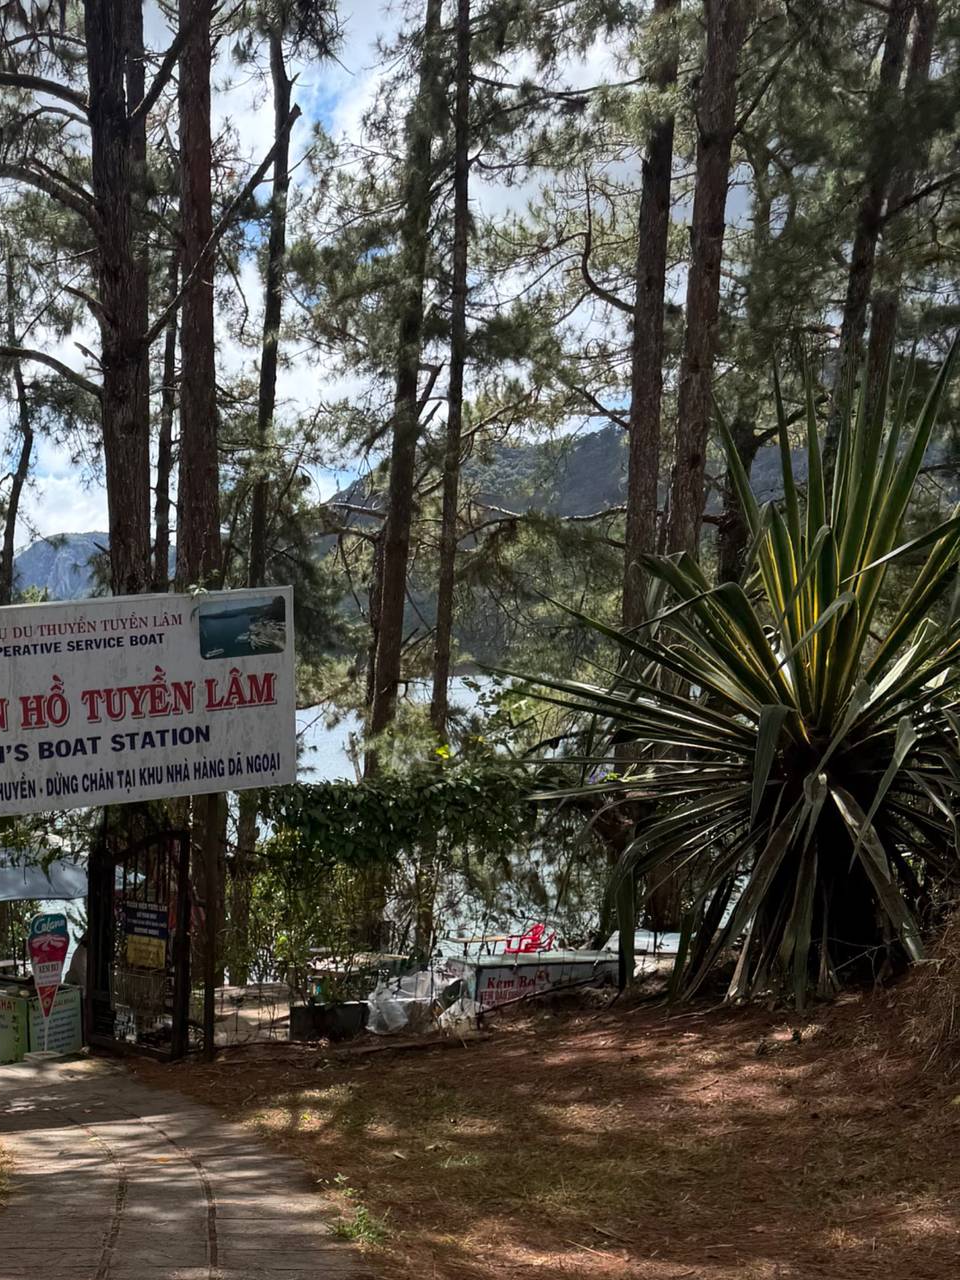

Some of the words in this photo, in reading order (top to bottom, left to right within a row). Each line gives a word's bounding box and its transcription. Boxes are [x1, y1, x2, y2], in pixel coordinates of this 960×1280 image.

[37, 615, 97, 637] THUYỀN
[100, 611, 149, 631] TUYỀN
[152, 612, 183, 628] LÂM
[67, 637, 125, 652] SERVICE
[129, 633, 165, 646] BOAT
[19, 674, 70, 730] HỒ
[81, 665, 194, 724] TUYỀN
[204, 667, 278, 712] LÂM
[38, 736, 102, 761] BOAT
[111, 724, 211, 753] STATION
[81, 769, 114, 791] CHÂN
[117, 769, 136, 793] TẠI
[139, 765, 163, 785] KHU
[167, 759, 190, 783] NHÀ
[193, 757, 225, 780] HÀNG
[246, 751, 280, 777] NGOẠI
